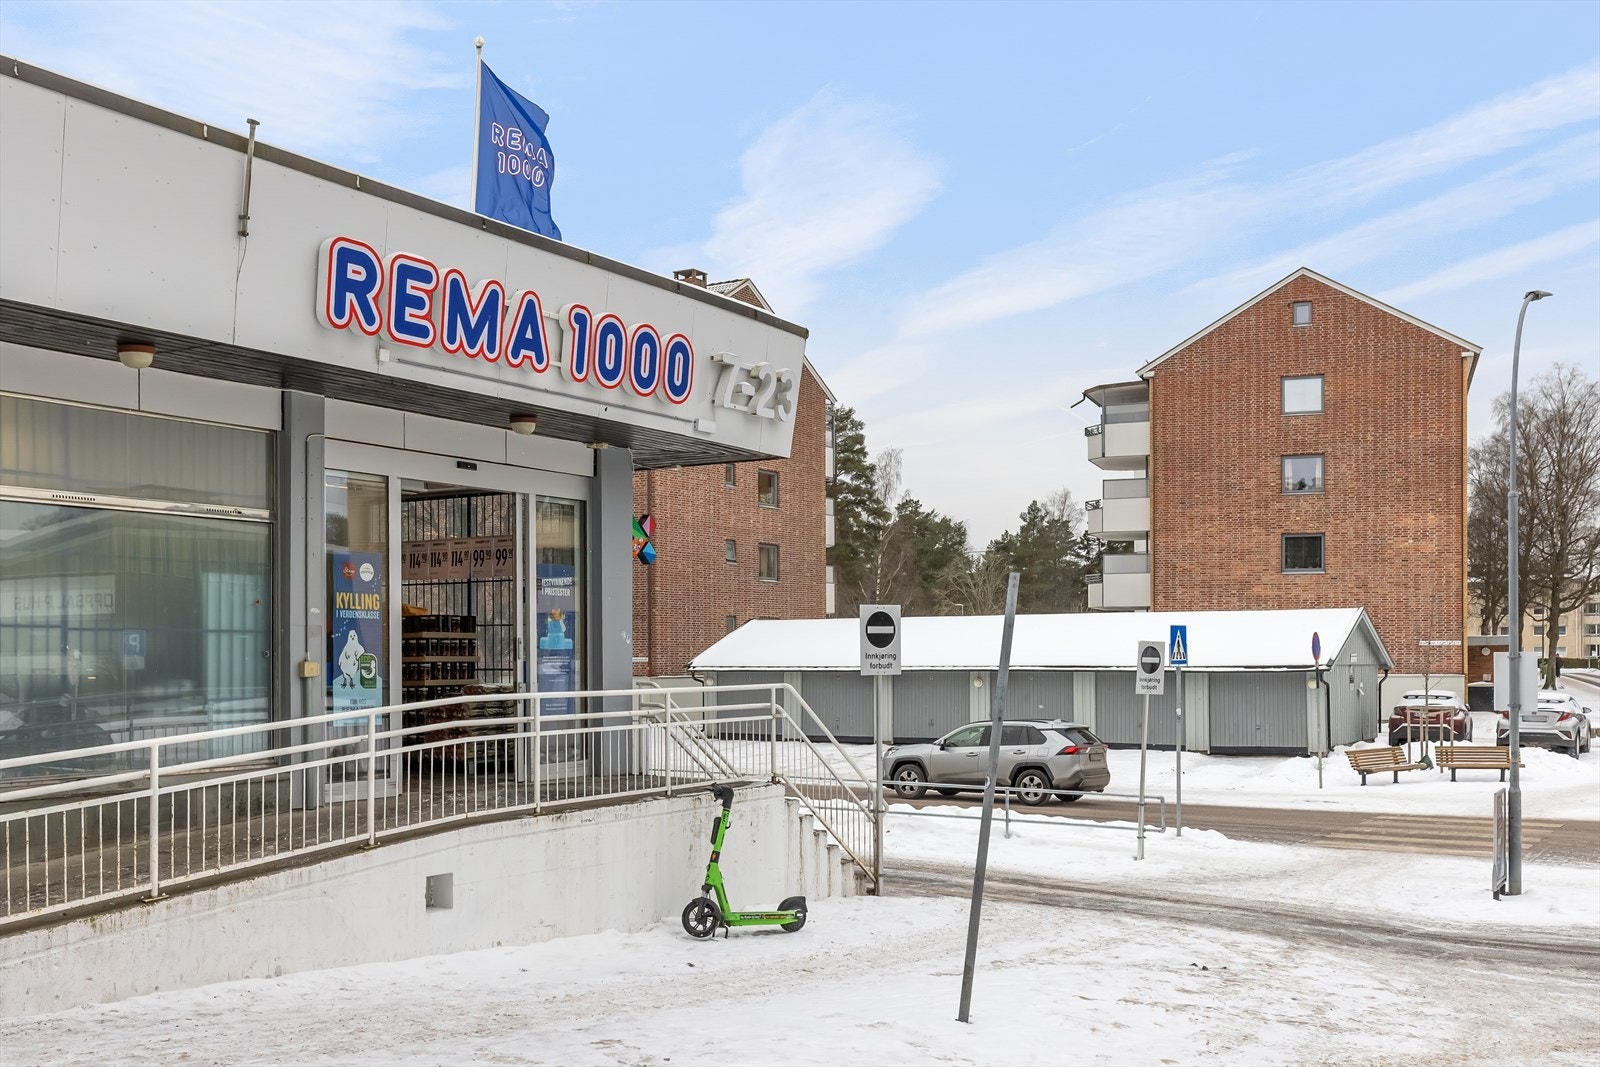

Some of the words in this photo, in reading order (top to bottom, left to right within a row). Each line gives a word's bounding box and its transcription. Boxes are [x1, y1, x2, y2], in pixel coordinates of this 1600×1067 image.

[491, 122, 549, 169] REMA
[497, 151, 545, 187] 1000
[324, 236, 550, 375] REMA
[564, 302, 695, 405] 1000
[711, 352, 797, 423] 7-23
[409, 552, 421, 569] 114
[430, 551, 442, 568] 114
[451, 550, 463, 567] 114
[473, 549, 485, 567] 99
[495, 548, 508, 567] 99
[336, 592, 380, 610] KYLLING
[340, 610, 380, 619] VERDENSKLASSE
[865, 652, 897, 661] Innkjøring
